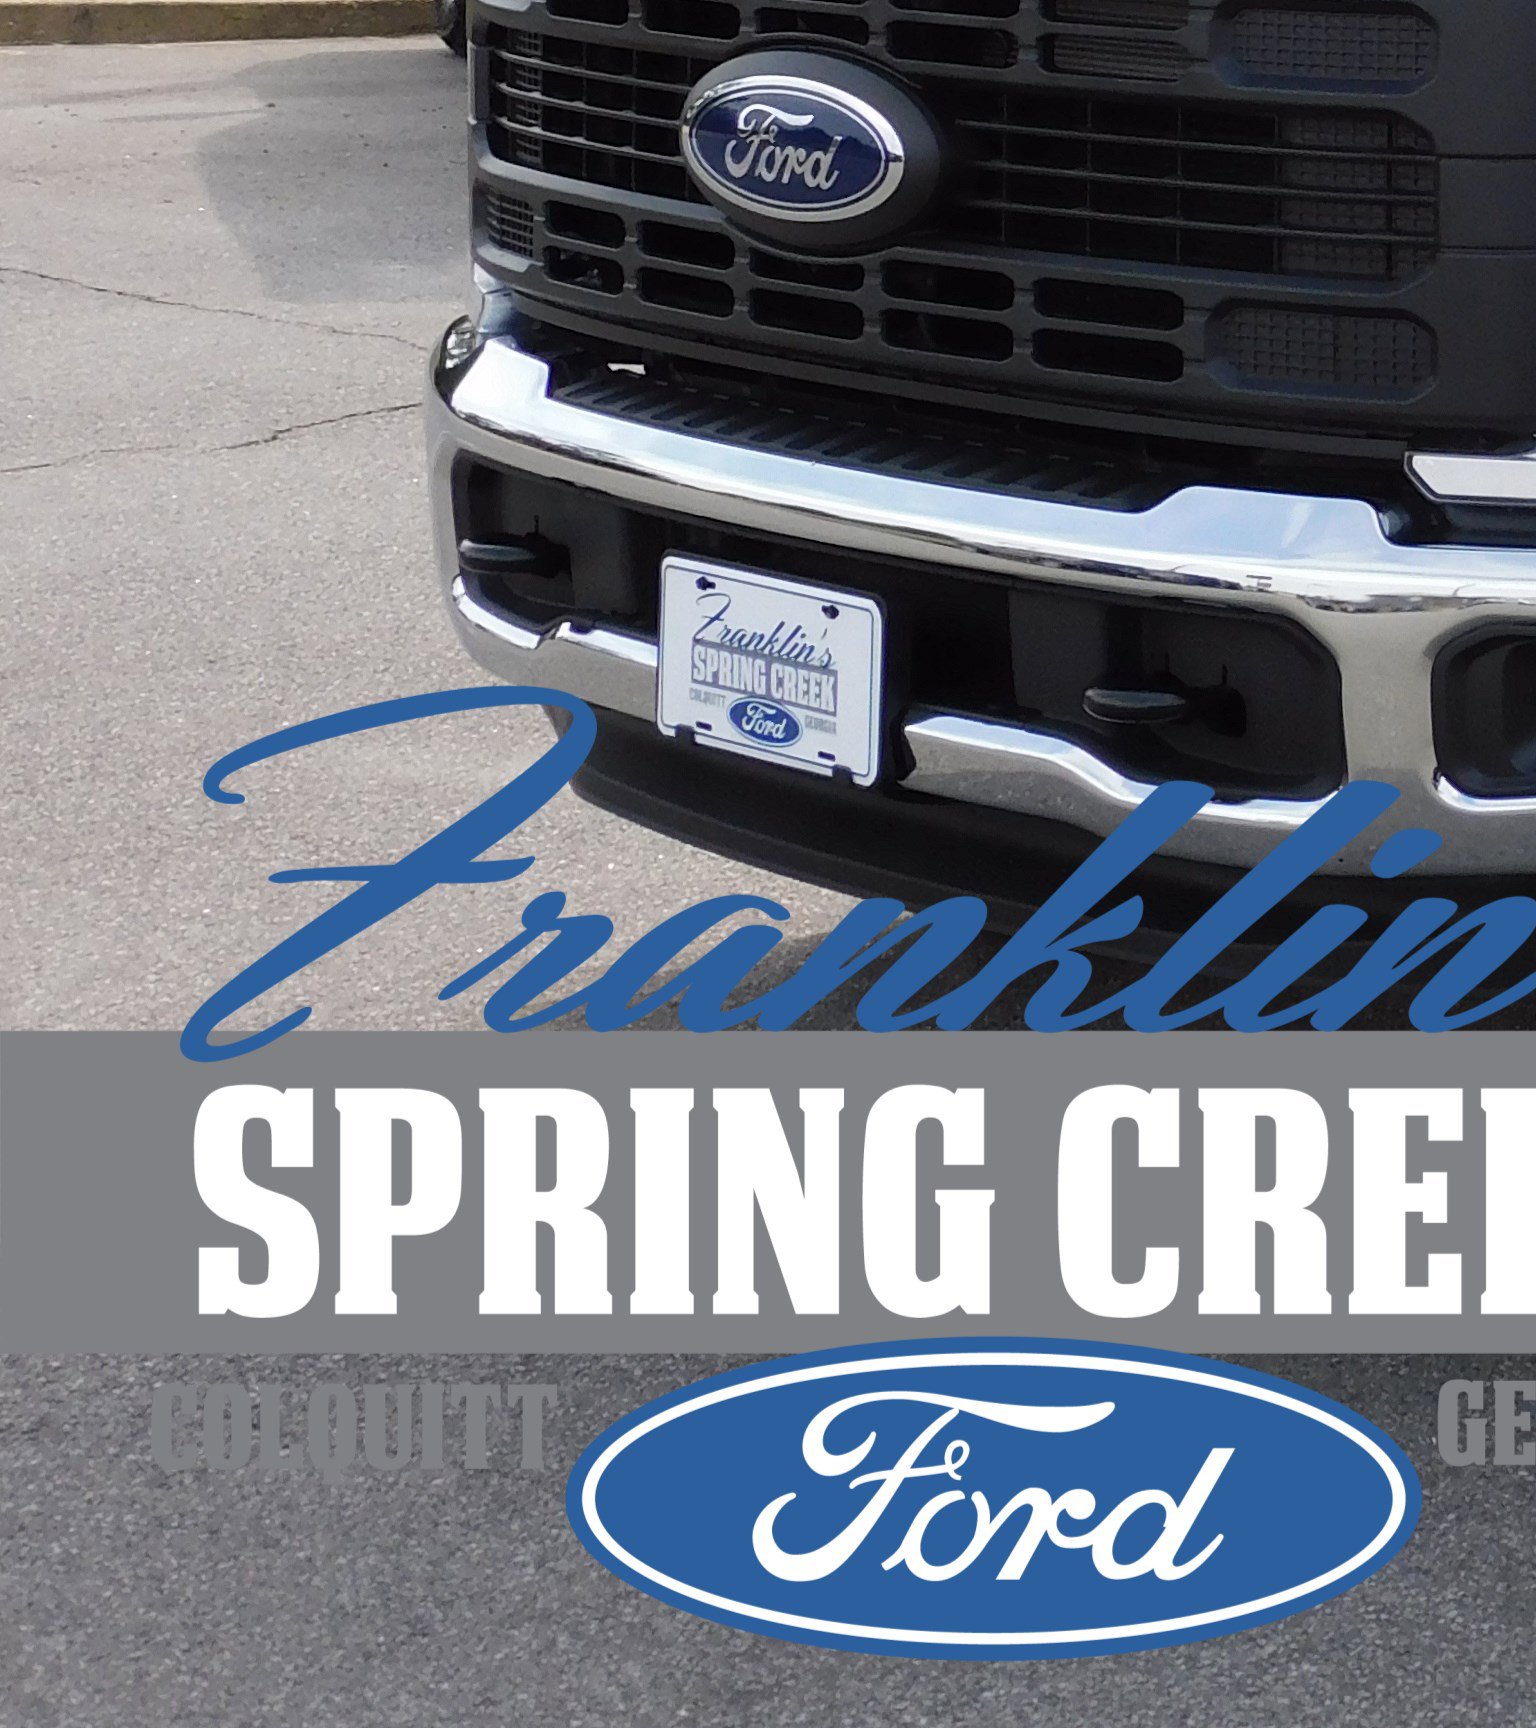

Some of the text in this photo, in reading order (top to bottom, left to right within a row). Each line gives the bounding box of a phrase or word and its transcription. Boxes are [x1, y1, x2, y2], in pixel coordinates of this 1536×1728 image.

[724, 103, 844, 191] Ford
[692, 592, 836, 669] Franklin's
[693, 644, 836, 714] SPRING CREEK
[741, 702, 787, 740] Ford
